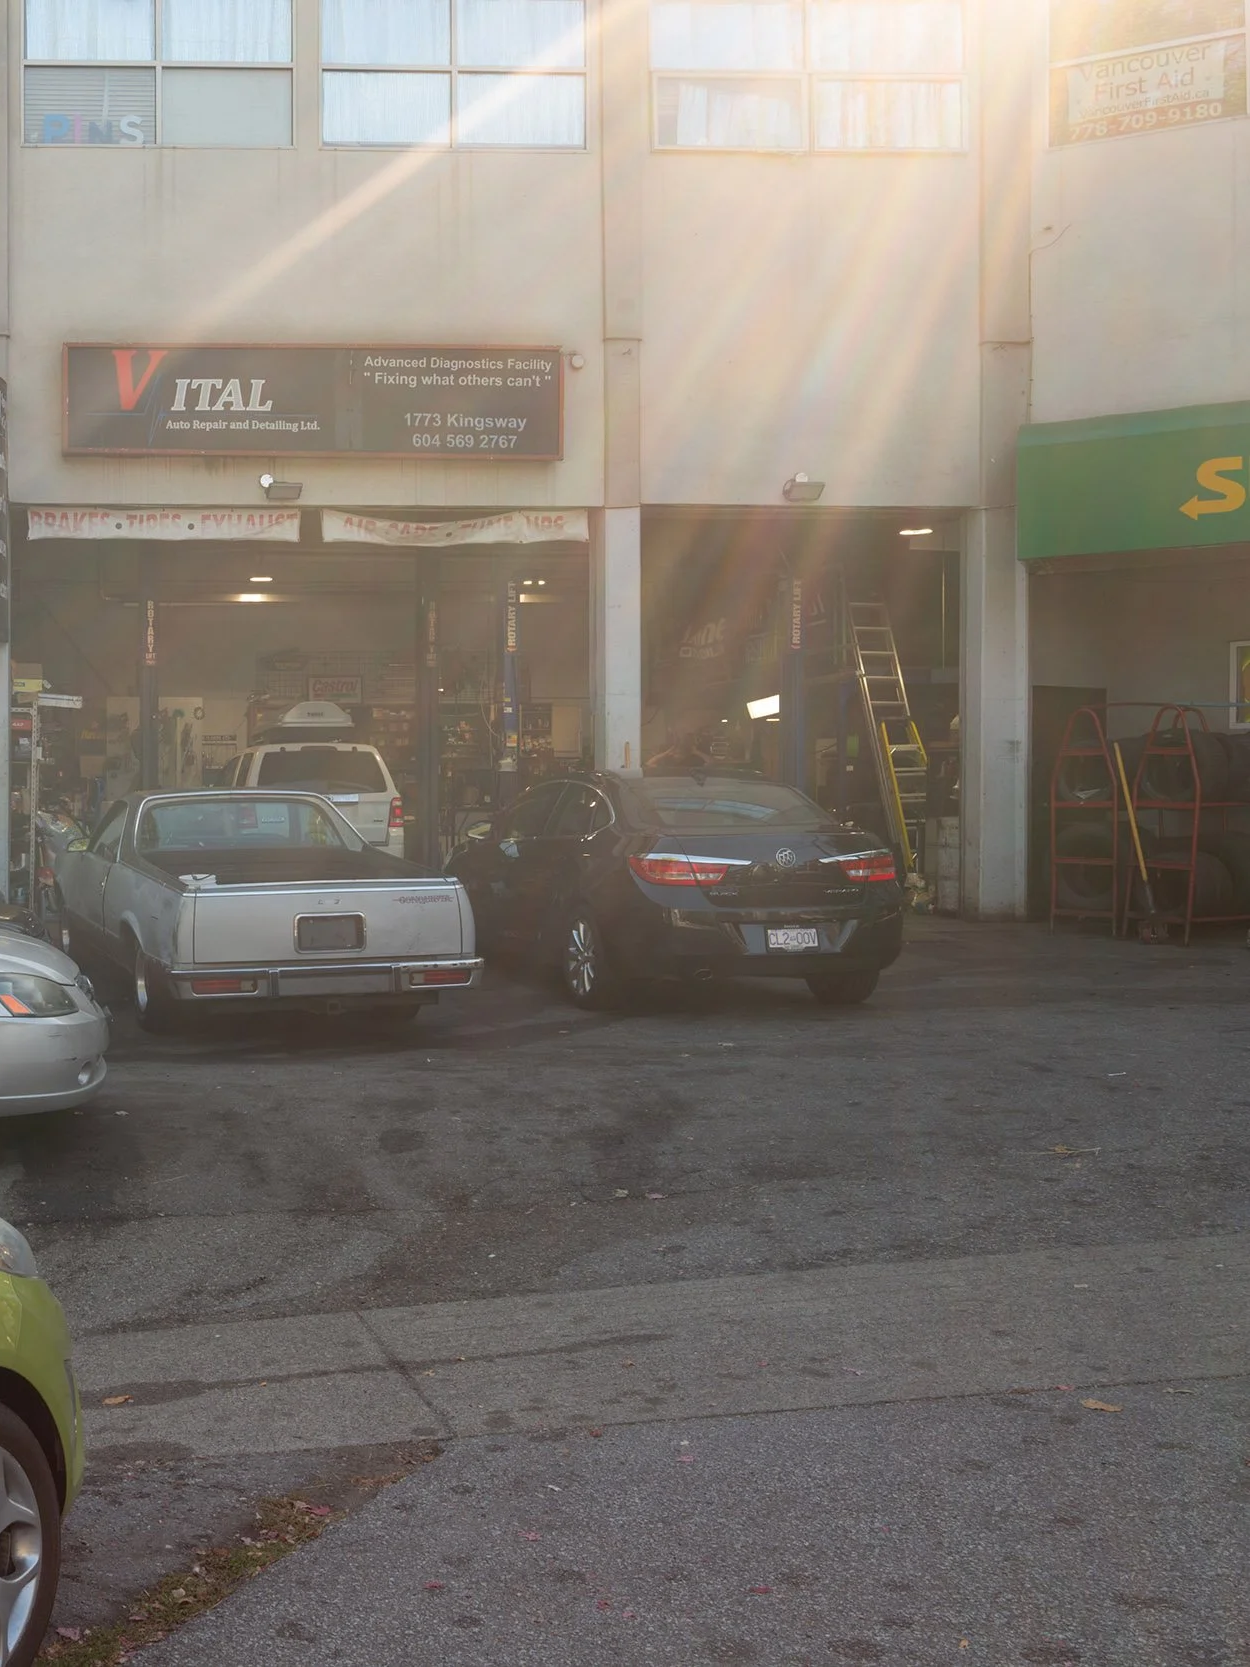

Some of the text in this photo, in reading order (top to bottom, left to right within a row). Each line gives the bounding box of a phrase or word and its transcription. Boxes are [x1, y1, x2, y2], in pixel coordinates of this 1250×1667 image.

[1077, 44, 1211, 81] Vancouver
[1094, 67, 1194, 101] First Aid
[1070, 102, 1222, 140] 778-709-9180
[364, 356, 552, 374] Advanced Diagnostics Facility
[421, 373, 454, 386] what
[458, 374, 502, 387] others
[166, 419, 320, 433] Auto Repair and Detailing Ltd.
[404, 413, 527, 432] 1773 Kingsway
[412, 434, 517, 448] 604 569 2767
[507, 606, 517, 646] ROTARY
[791, 604, 802, 644] ROTARY
